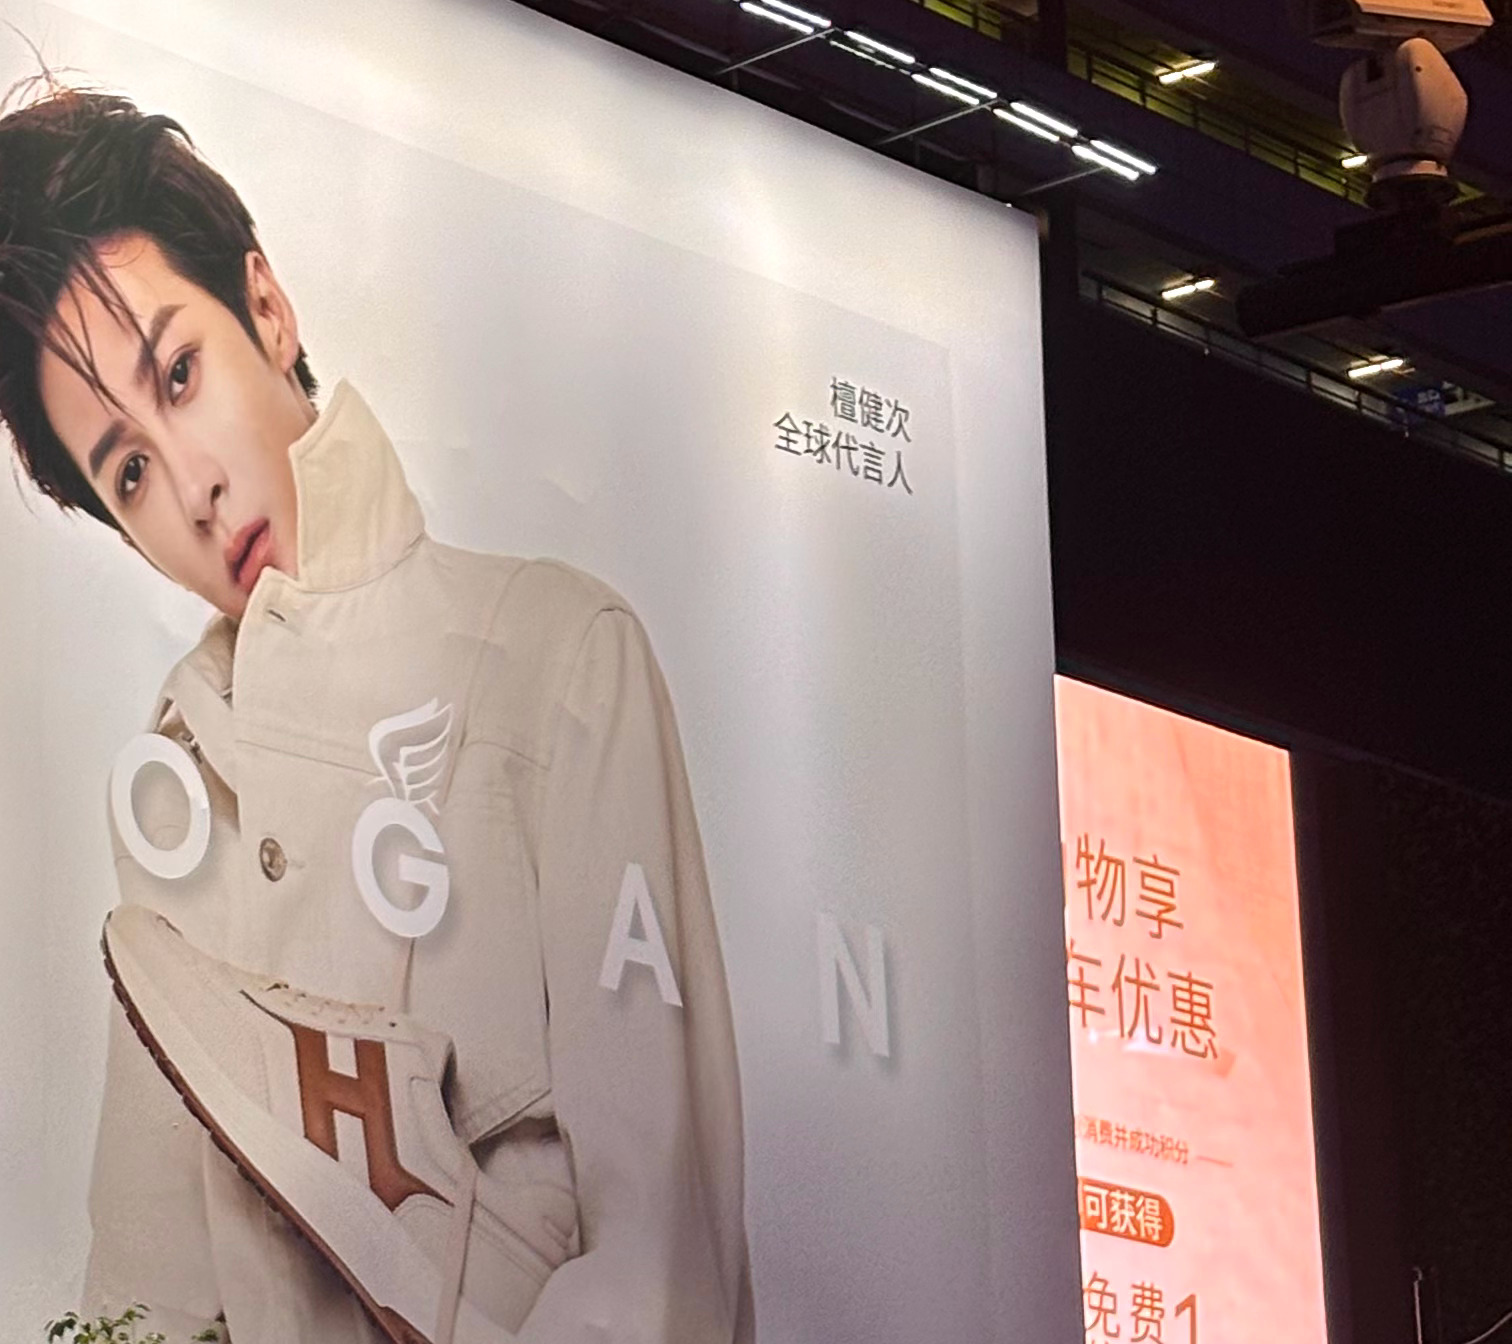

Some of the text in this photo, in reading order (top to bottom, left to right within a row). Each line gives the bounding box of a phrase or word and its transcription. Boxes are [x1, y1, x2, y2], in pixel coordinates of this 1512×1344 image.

[829, 376, 912, 443] 檀健次
[773, 411, 913, 495] 全球代言人
[1075, 832, 1184, 940] 物享
[1083, 1184, 1163, 1241] 可获得
